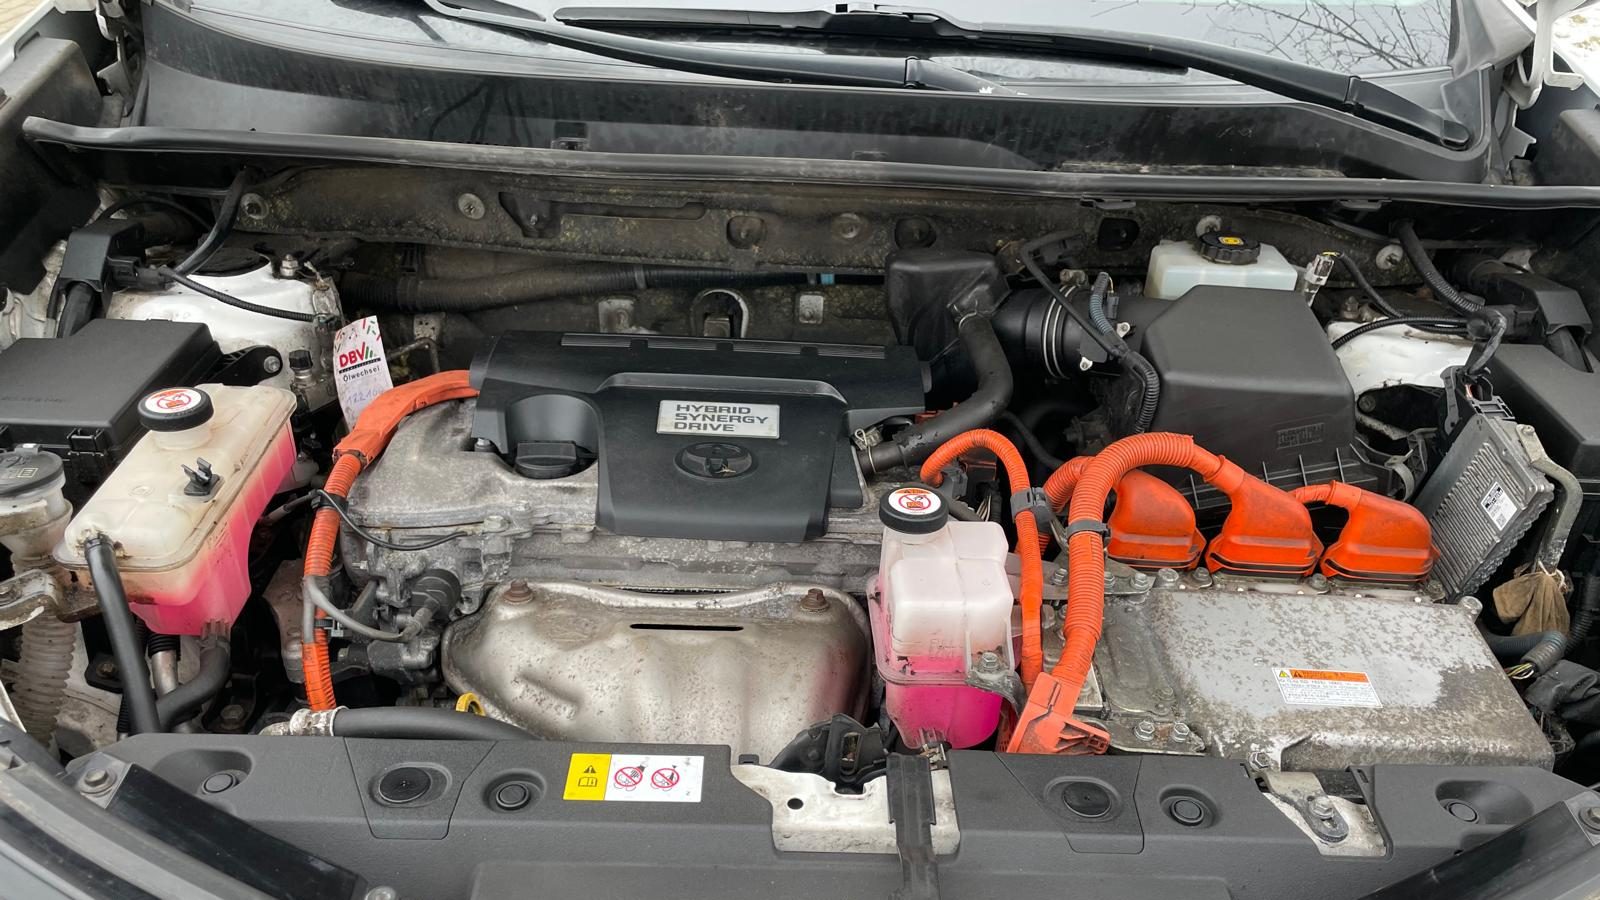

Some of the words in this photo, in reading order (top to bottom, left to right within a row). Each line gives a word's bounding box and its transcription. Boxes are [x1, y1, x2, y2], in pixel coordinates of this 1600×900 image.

[343, 365, 380, 382] Ölwechsel
[676, 404, 750, 414] HYBRID
[675, 413, 768, 424] SYNERGY
[674, 421, 735, 432] DRIVE
